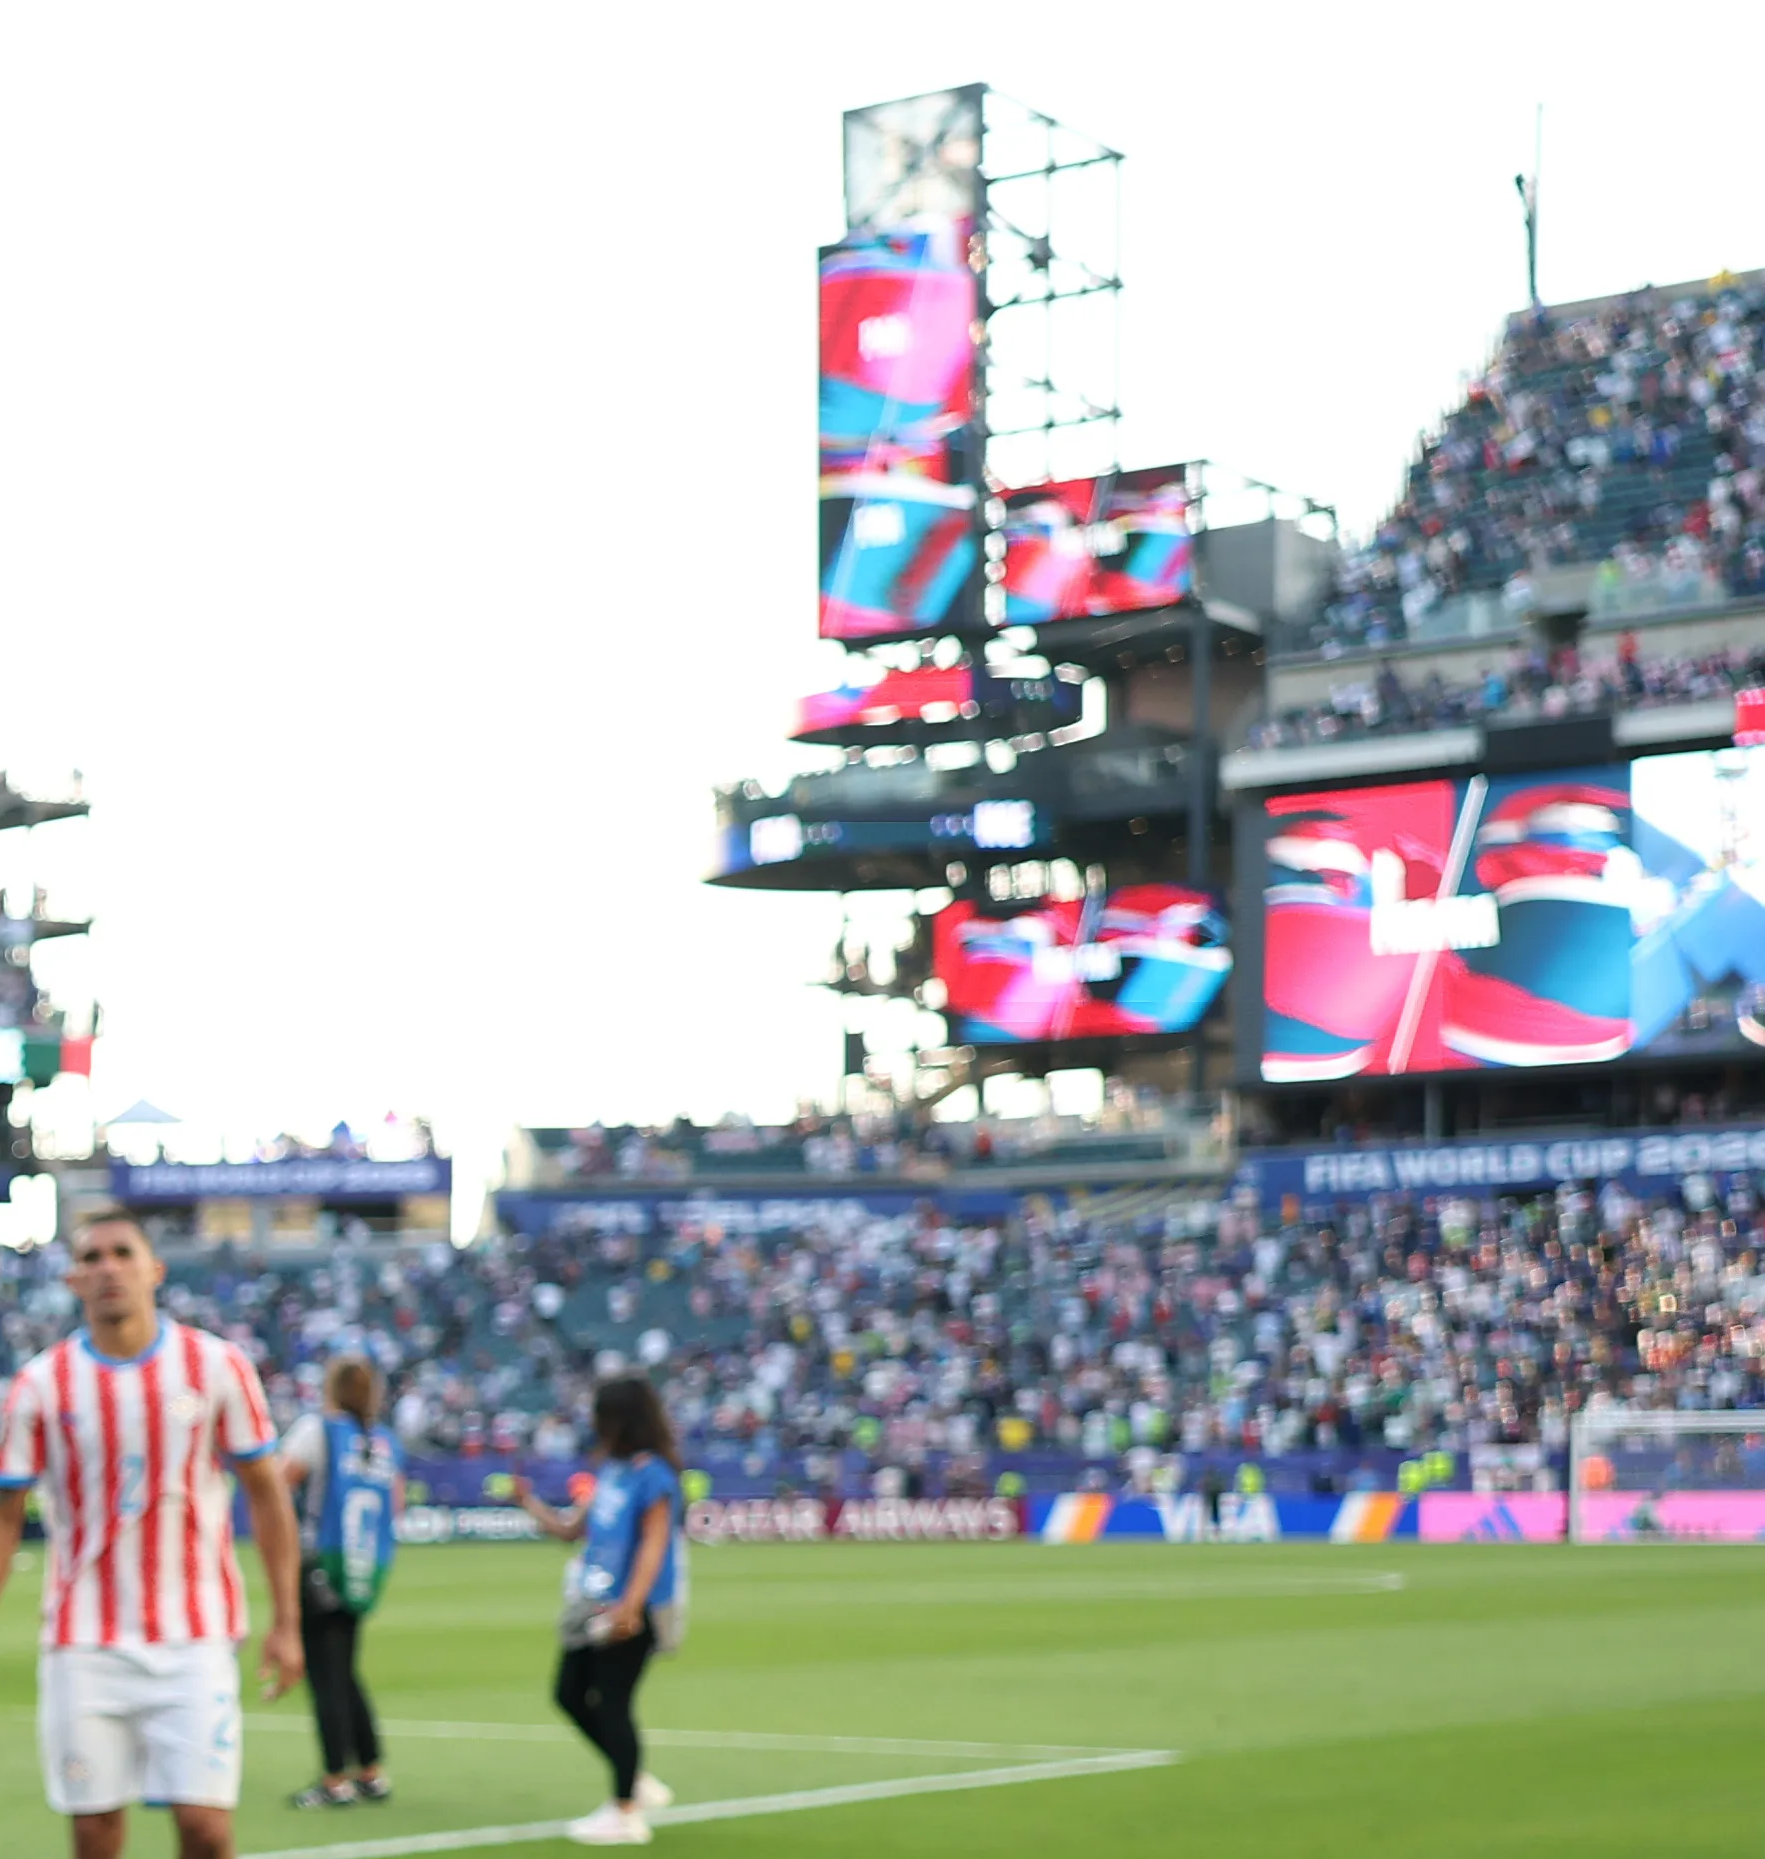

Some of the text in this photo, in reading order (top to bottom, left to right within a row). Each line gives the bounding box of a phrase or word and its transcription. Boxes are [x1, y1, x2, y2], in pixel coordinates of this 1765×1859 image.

[1305, 1150, 1393, 1192] FIFA
[1395, 1144, 1543, 1187] WORLD
[1545, 1138, 1633, 1180] CUP
[685, 1497, 1019, 1545] QATAR AIRWAYS
